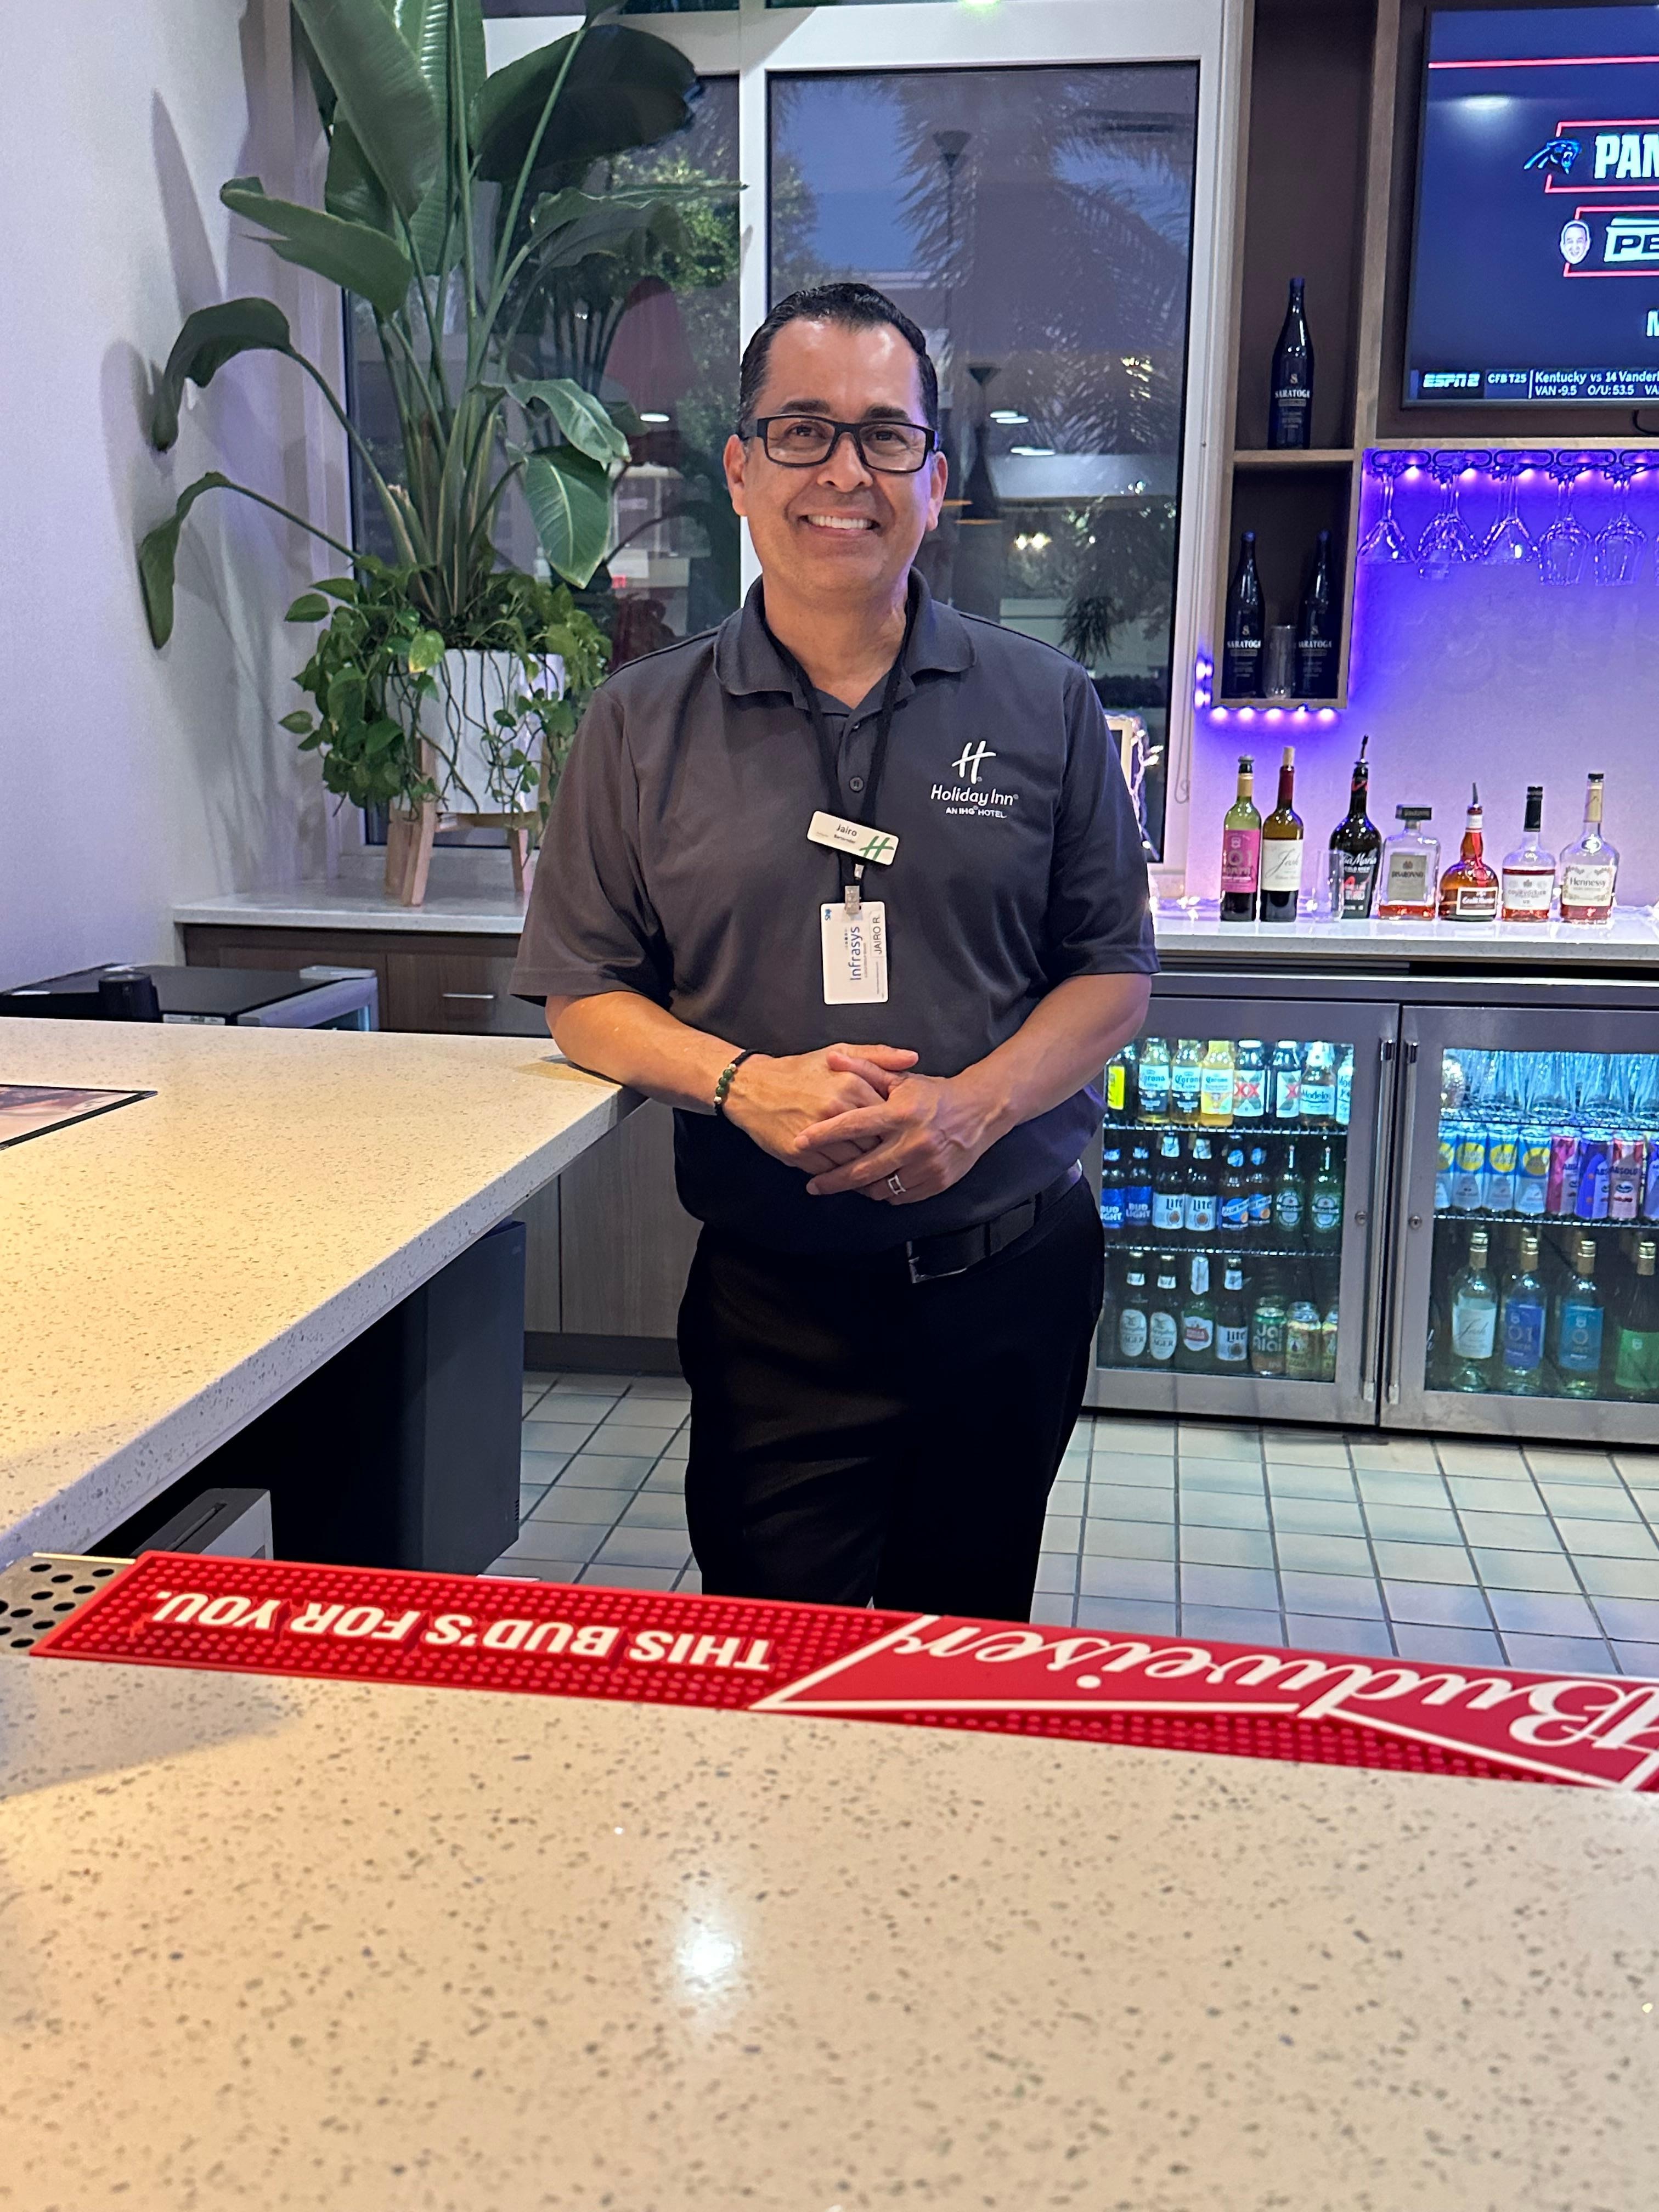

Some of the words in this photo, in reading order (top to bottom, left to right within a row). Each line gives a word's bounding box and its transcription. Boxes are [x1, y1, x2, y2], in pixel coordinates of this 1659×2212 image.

[1487, 374, 1508, 383] CFB
[1509, 374, 1527, 383] T25
[1535, 371, 1587, 385] Kentucky
[1590, 374, 1602, 382] vs
[1605, 371, 1617, 382] 14
[1535, 385, 1556, 395] VAN
[1558, 385, 1577, 396] -9.5
[930, 784, 989, 806] Holiday
[978, 809, 1007, 819] HOTEL
[837, 823, 857, 837] Jairo
[1570, 877, 1606, 887] Hennessy
[873, 926, 882, 954] JAIRO
[848, 927, 862, 980] Infrasys
[1175, 1075, 1199, 1084] Coron
[1126, 1210, 1150, 1218] LIGHT
[1128, 1203, 1148, 1211] BUD
[1256, 1325, 1283, 1337] Jai
[1252, 1336, 1282, 1351] Alai
[153, 1592, 281, 1629] YOU.
[290, 1603, 421, 1640] FOR
[425, 1614, 619, 1657] BUD'S
[629, 1630, 770, 1671] THIS
[895, 1627, 1659, 1749] Budweiser
